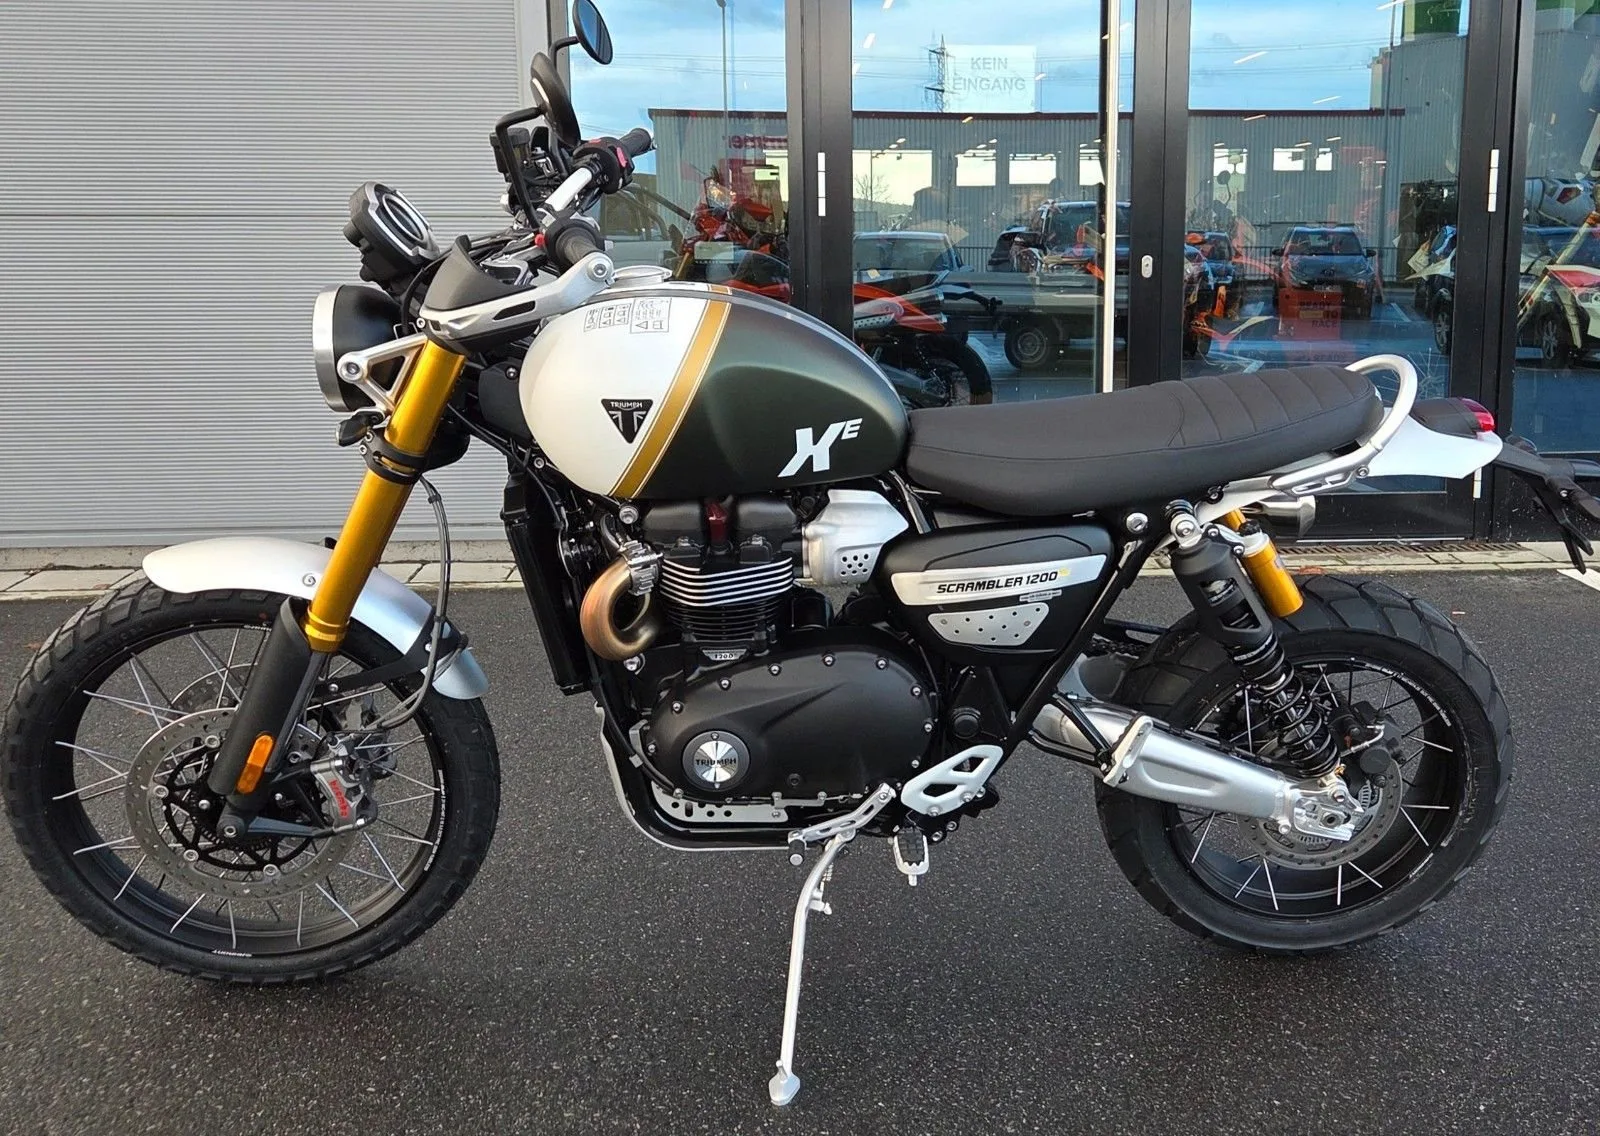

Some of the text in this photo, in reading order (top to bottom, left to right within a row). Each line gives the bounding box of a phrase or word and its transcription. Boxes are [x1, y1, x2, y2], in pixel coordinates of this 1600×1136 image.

[970, 57, 1008, 70] KEIN
[952, 77, 1026, 91] EINGANG
[1311, 320, 1338, 328] RACE
[610, 401, 643, 409] TRIUMPH
[936, 576, 1024, 594] SCRAMBLER
[1026, 571, 1059, 585] 1200
[695, 757, 737, 767] TRIUMPH
